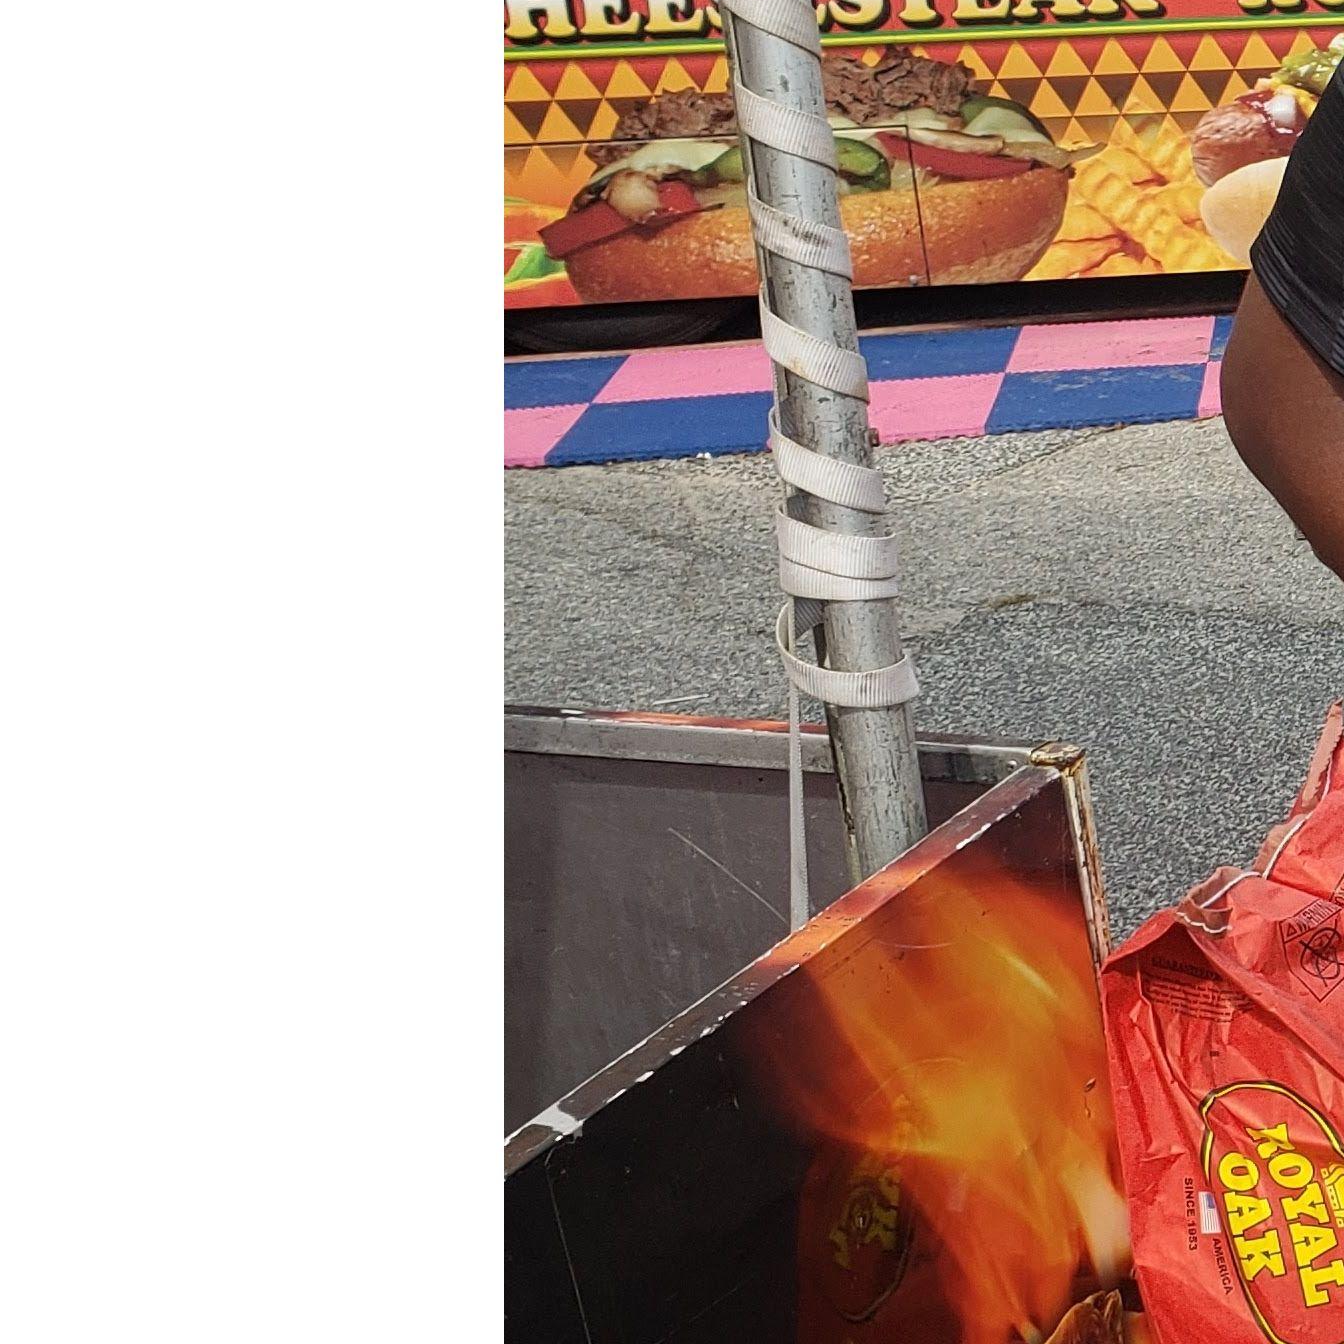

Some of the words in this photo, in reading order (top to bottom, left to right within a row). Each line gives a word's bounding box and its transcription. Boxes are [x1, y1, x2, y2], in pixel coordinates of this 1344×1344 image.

[1184, 1177, 1195, 1217] SINCE
[1217, 1152, 1287, 1282] OAK
[1186, 1219, 1198, 1251] 1953
[1212, 1237, 1234, 1296] AMERICA
